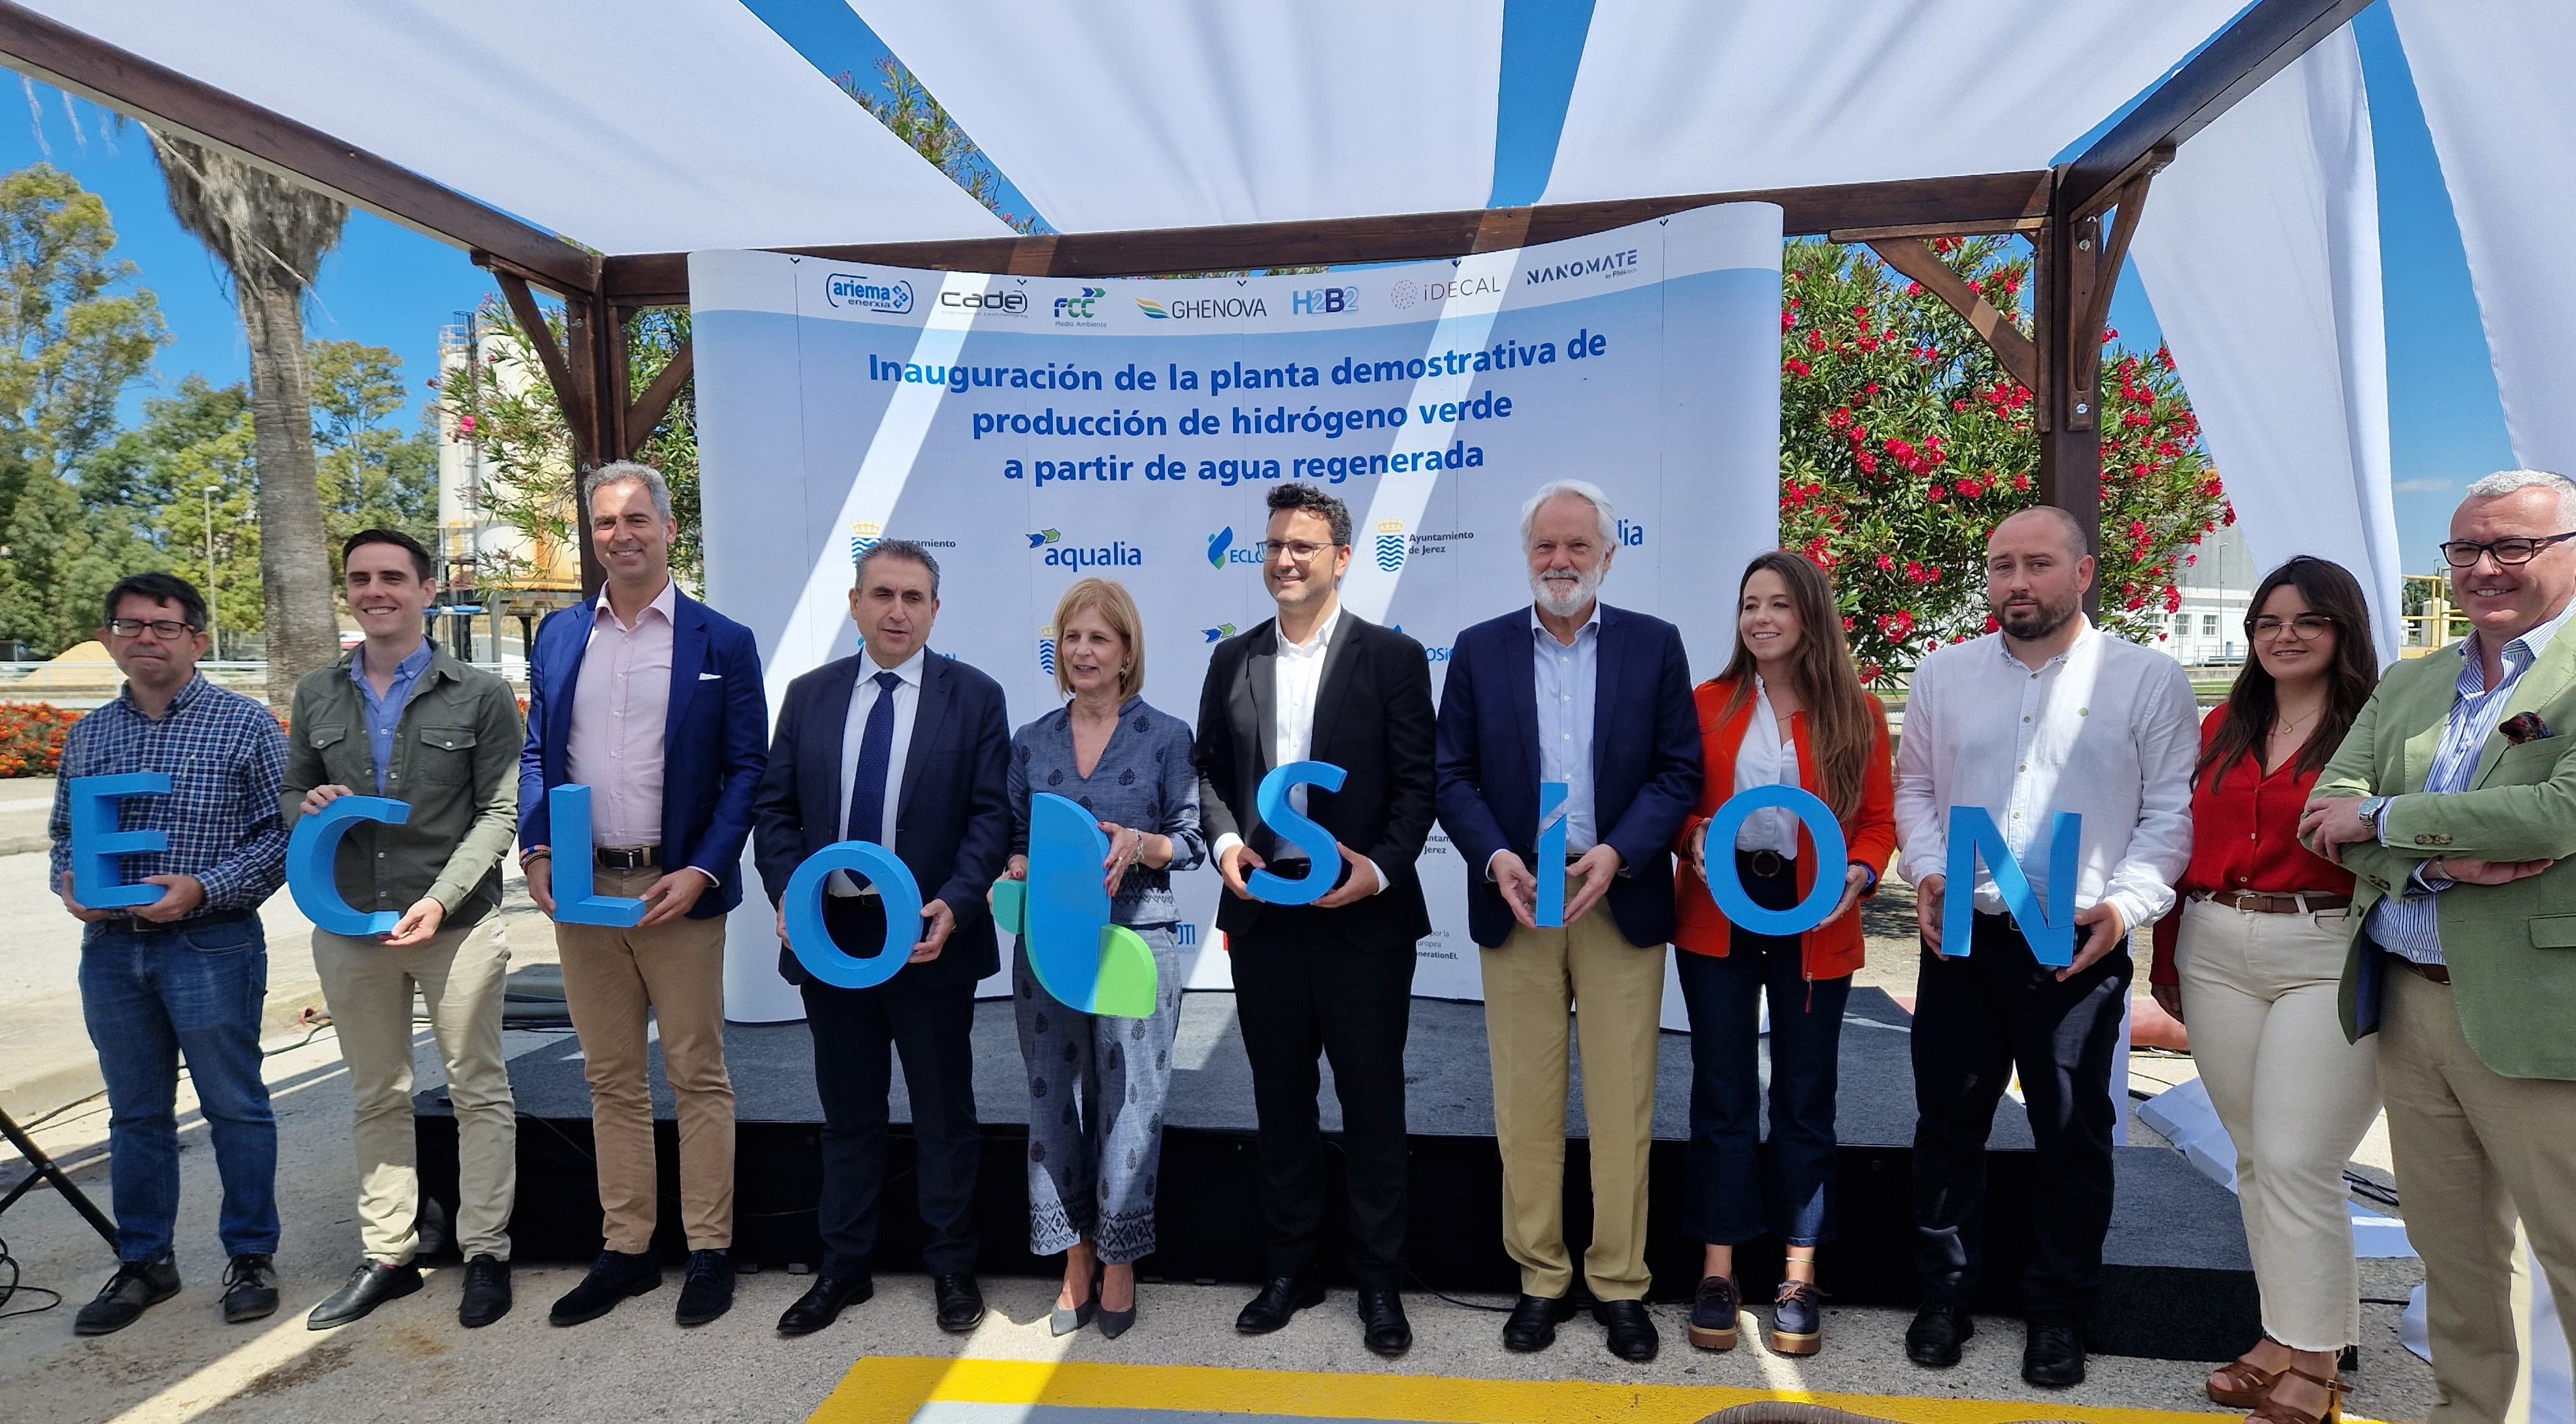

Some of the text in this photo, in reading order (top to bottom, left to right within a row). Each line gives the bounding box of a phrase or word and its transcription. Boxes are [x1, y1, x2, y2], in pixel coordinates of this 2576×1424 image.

[1527, 248, 1638, 285] NANOMATE
[833, 280, 890, 301] ariema
[1292, 286, 1359, 315] H2B2
[1424, 275, 1501, 302] iDECAL
[1054, 297, 1095, 318] FCC
[1172, 298, 1268, 319] GHENOVA
[869, 328, 1607, 397] Inauguración de la planta demostrativa de
[973, 389, 1513, 440] producción de hidrógeno verde
[1004, 440, 1483, 488] a partir de agua regenerada
[900, 538, 956, 548] tamiento
[1409, 531, 1474, 544] Ayuntamiento
[1409, 545, 1446, 555] de Jerez
[1044, 541, 1141, 572] aqualia
[1424, 845, 1446, 854] Jerez
[70, 772, 172, 908] E
[286, 795, 412, 936] C
[549, 784, 646, 928] L
[1245, 760, 1348, 905] S
[1941, 805, 2082, 967] N
